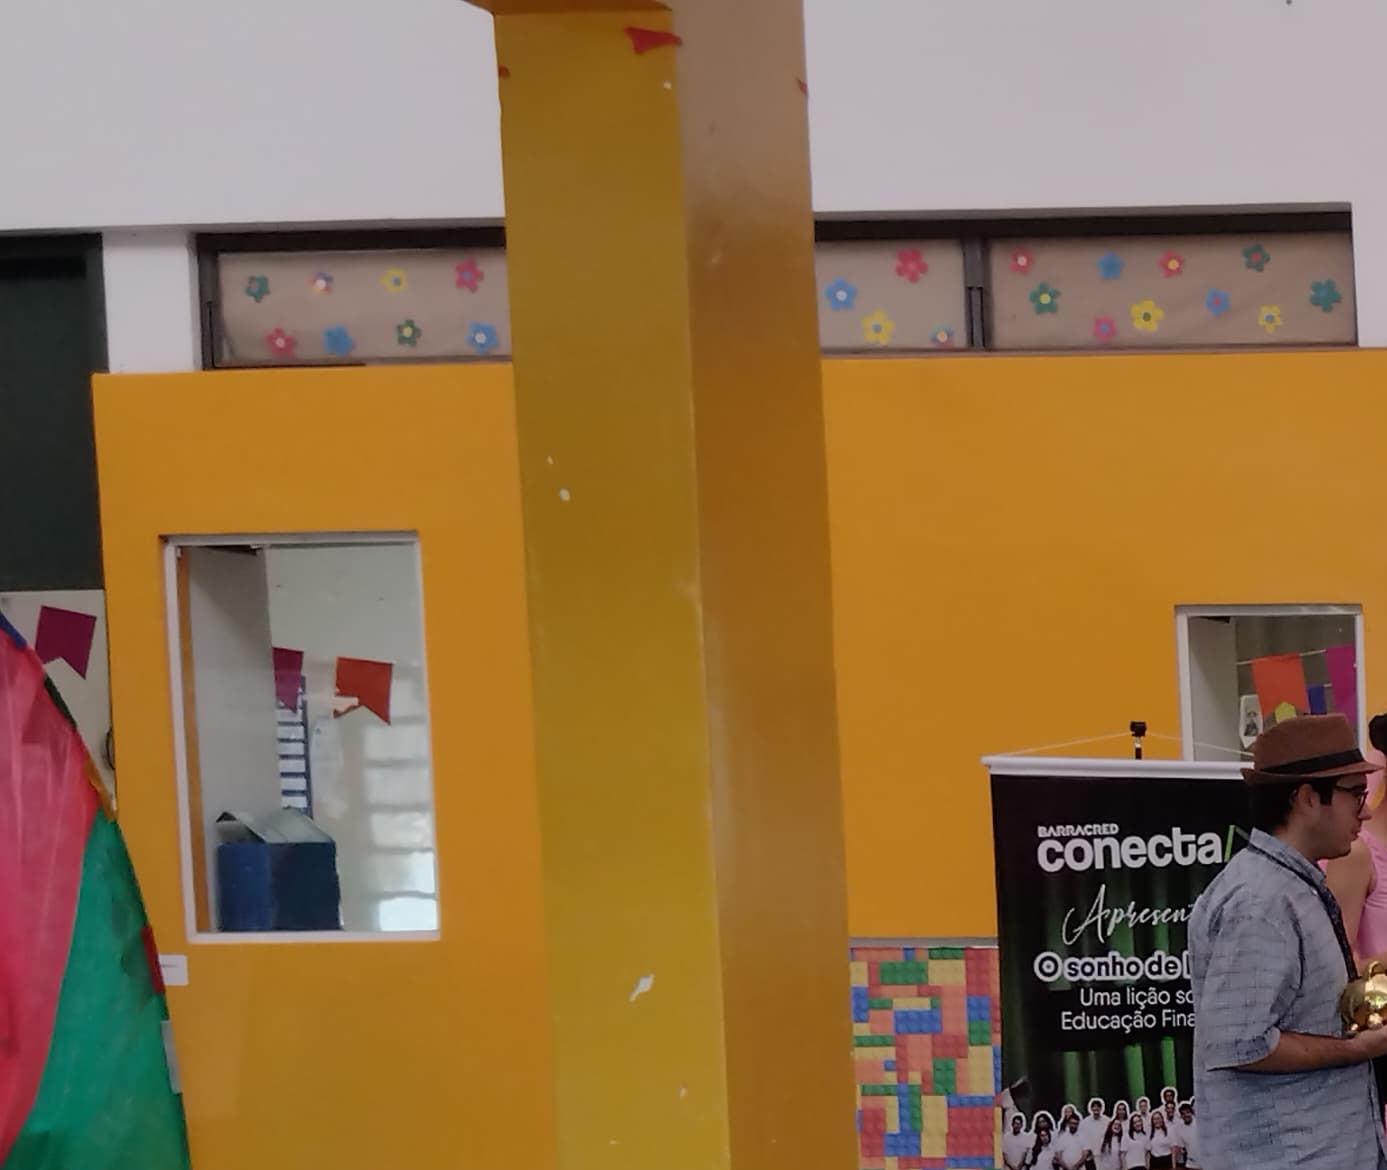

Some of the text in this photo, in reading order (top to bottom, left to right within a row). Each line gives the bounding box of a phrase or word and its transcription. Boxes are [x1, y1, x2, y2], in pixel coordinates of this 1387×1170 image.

[1037, 823, 1119, 838] BARRACRED
[1034, 951, 1063, 982] O
[1064, 951, 1144, 982] sonho
[1145, 950, 1182, 980] de
[1080, 988, 1121, 1006] Uma
[1126, 986, 1171, 1010] lição
[1061, 1009, 1196, 1034] Educação Fina
